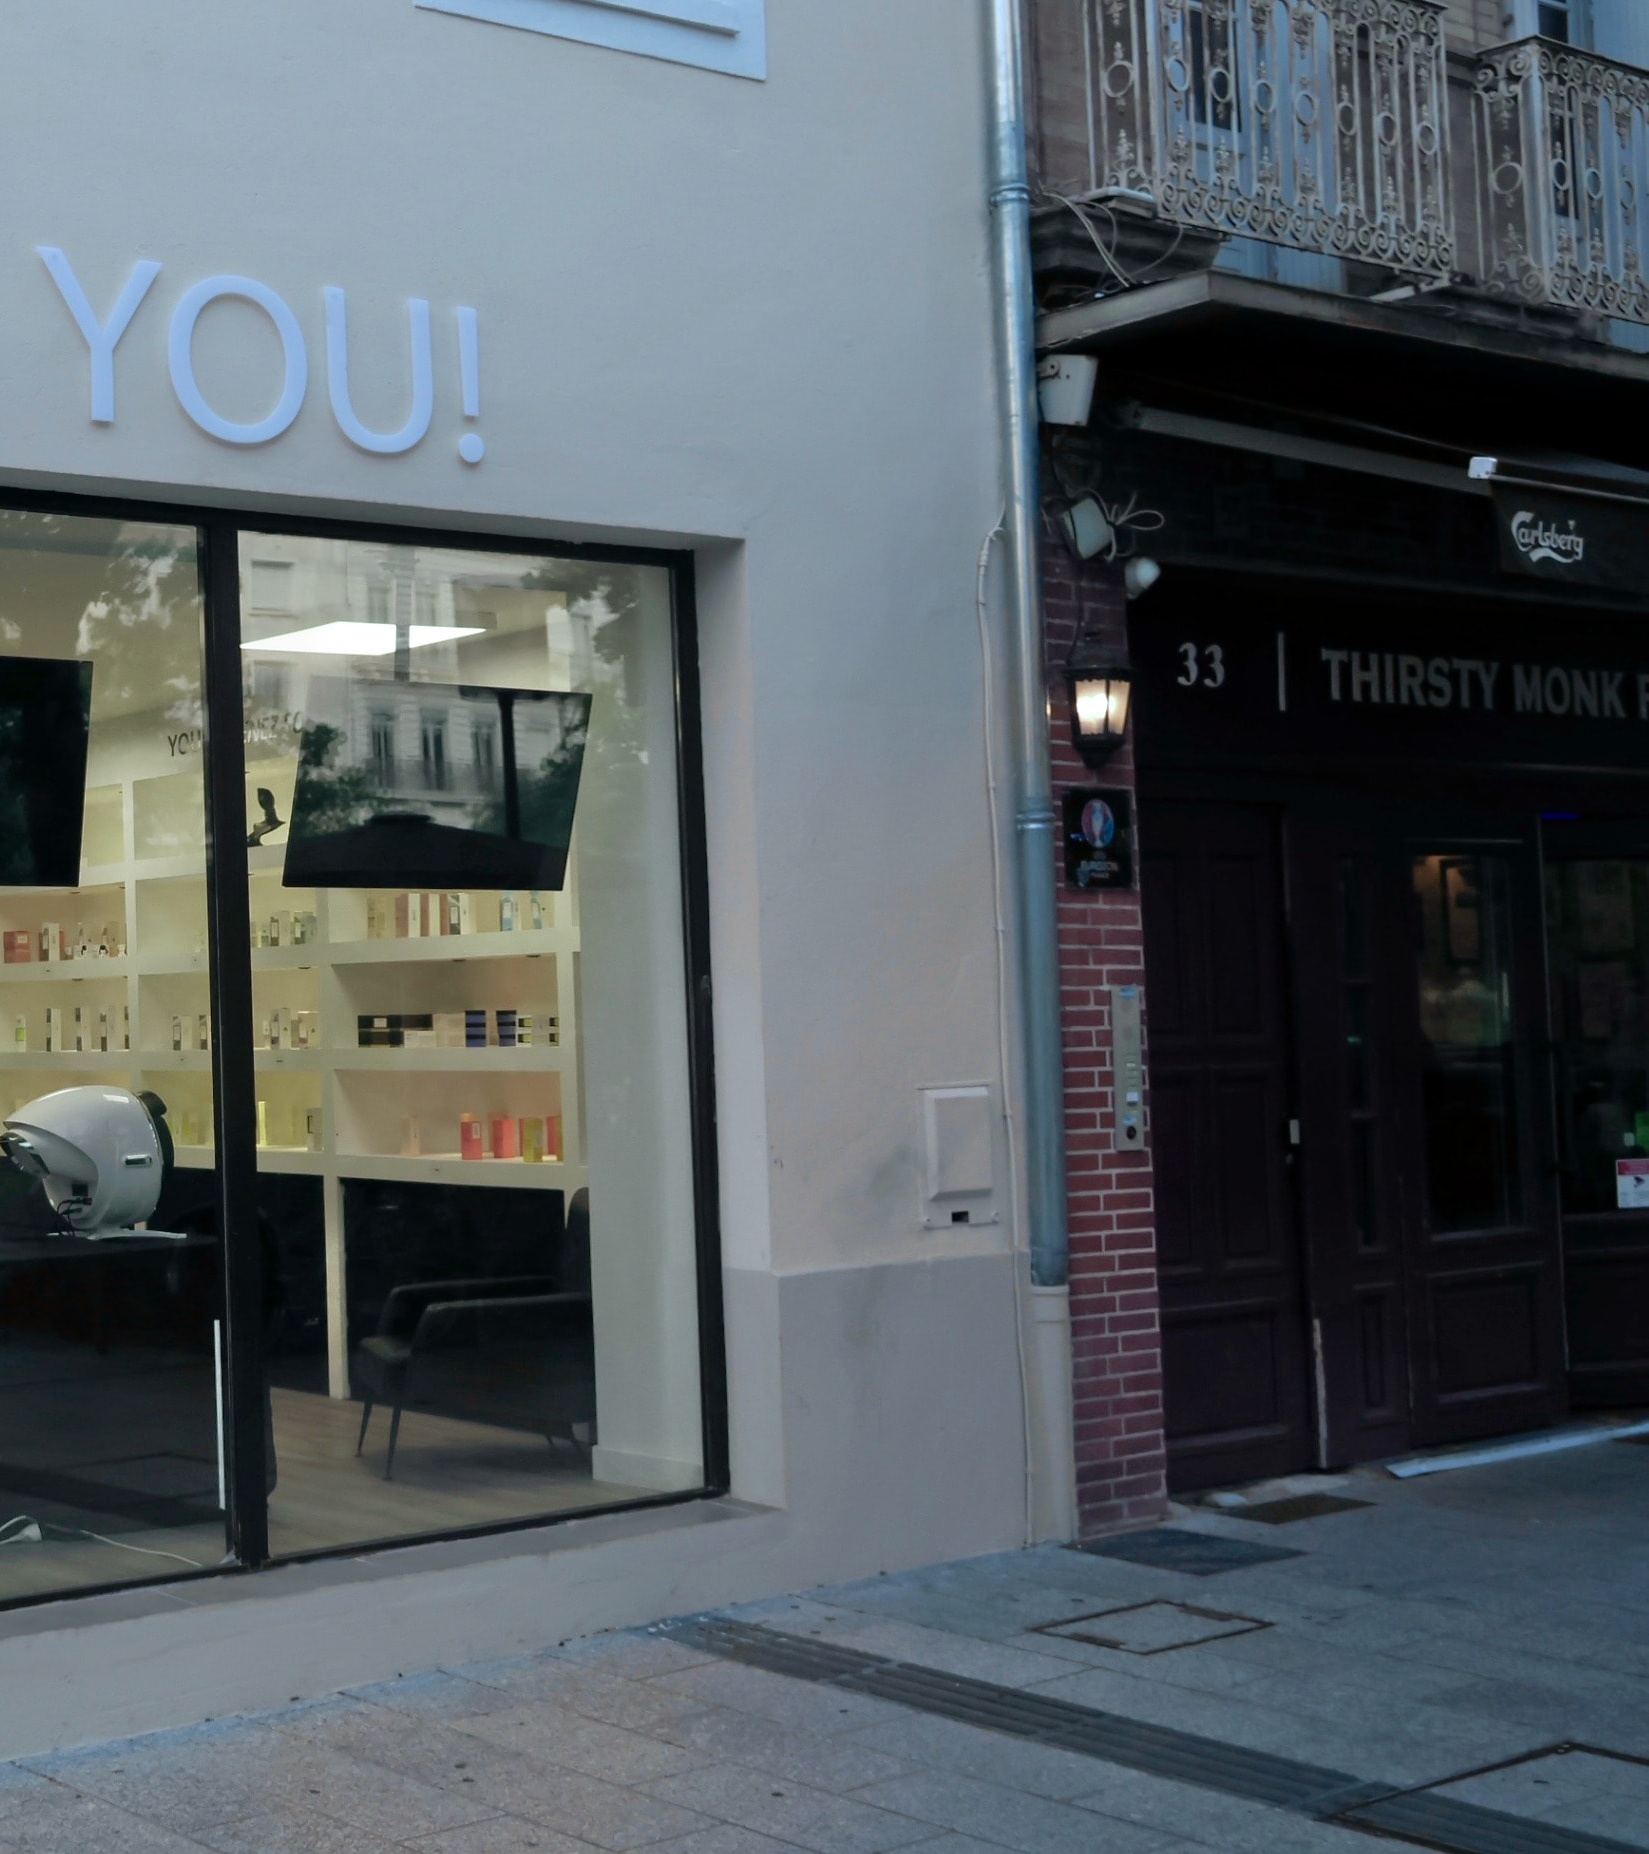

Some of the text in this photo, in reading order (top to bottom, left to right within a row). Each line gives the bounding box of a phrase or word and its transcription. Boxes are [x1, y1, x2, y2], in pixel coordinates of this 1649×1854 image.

[35, 245, 485, 463] YOU!
[1511, 510, 1584, 562] Carlsberg
[1177, 642, 1225, 688] 33
[1321, 647, 1501, 711] THIRSTY
[1513, 663, 1627, 719] MONK
